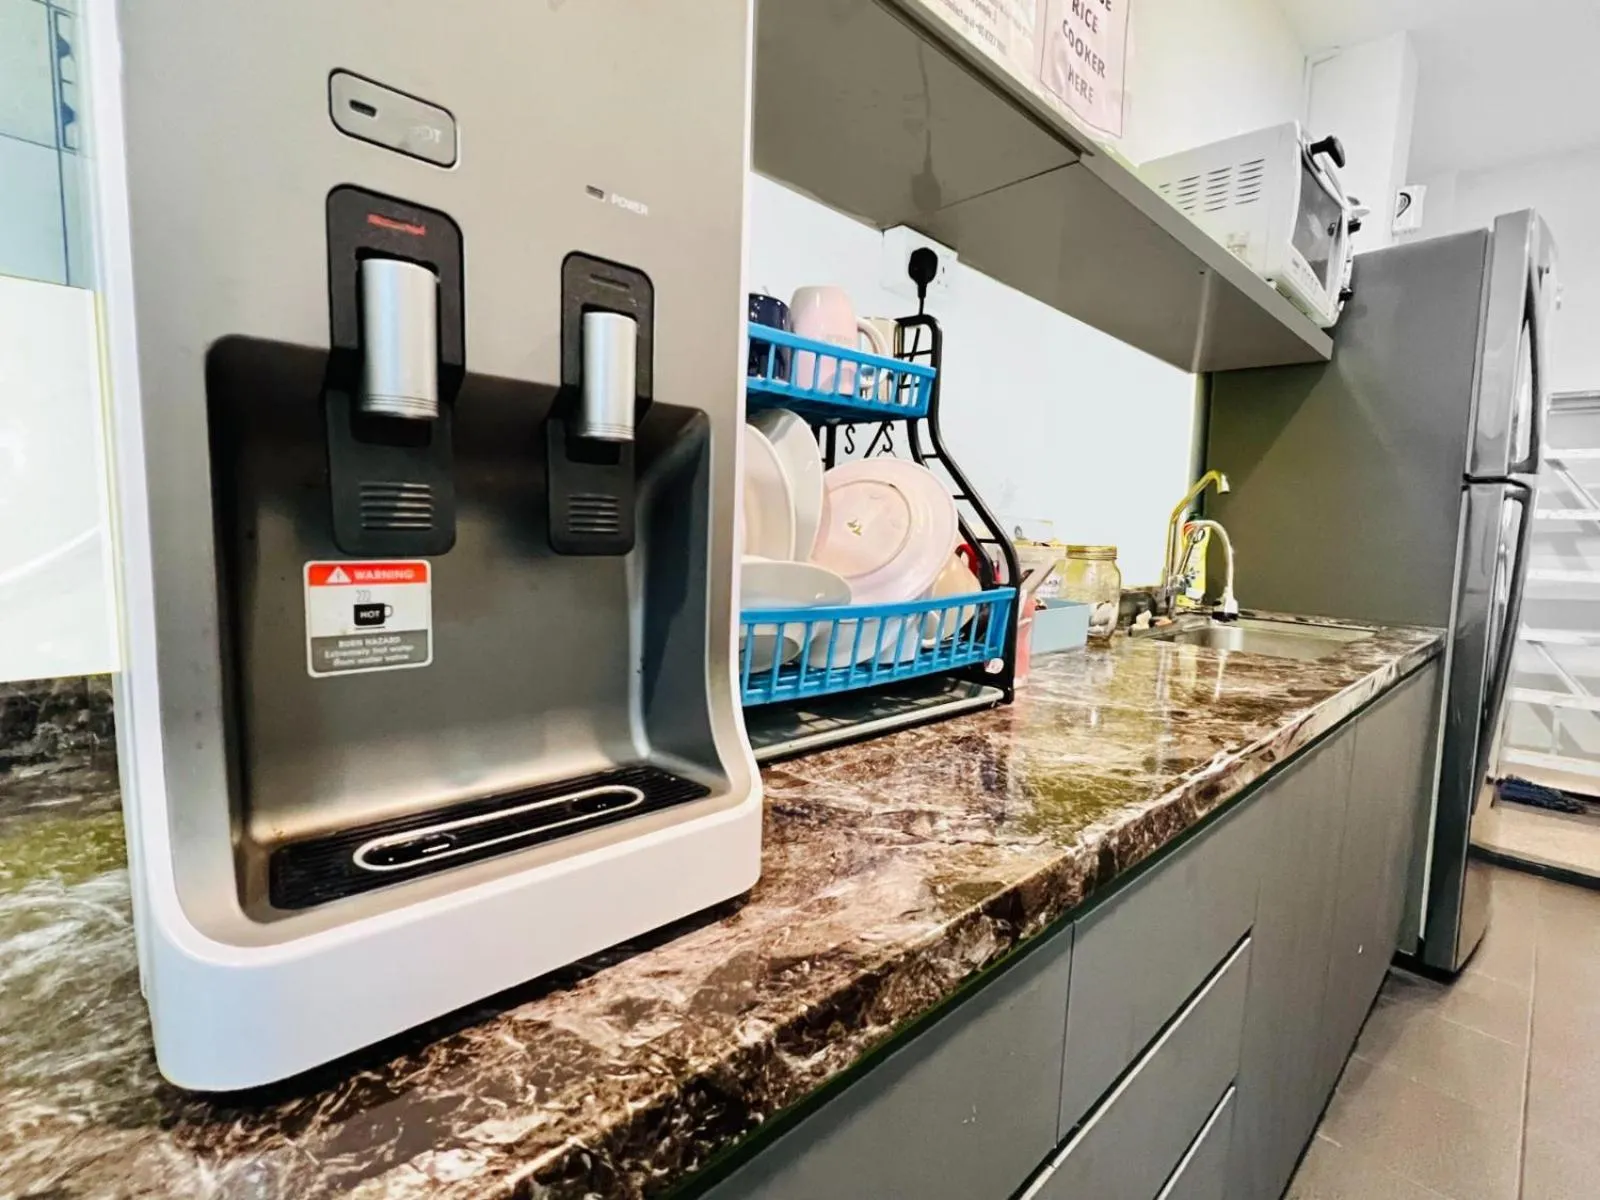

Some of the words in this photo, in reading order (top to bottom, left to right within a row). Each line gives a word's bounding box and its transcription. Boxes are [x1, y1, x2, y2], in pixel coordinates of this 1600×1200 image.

[1072, 0, 1098, 34] RICE
[1062, 19, 1105, 79] COOKER
[1068, 63, 1094, 104] HERE
[611, 193, 648, 216] POWER
[354, 569, 414, 580] WARNING
[360, 610, 380, 619] HOT
[365, 636, 400, 646] HAZARD
